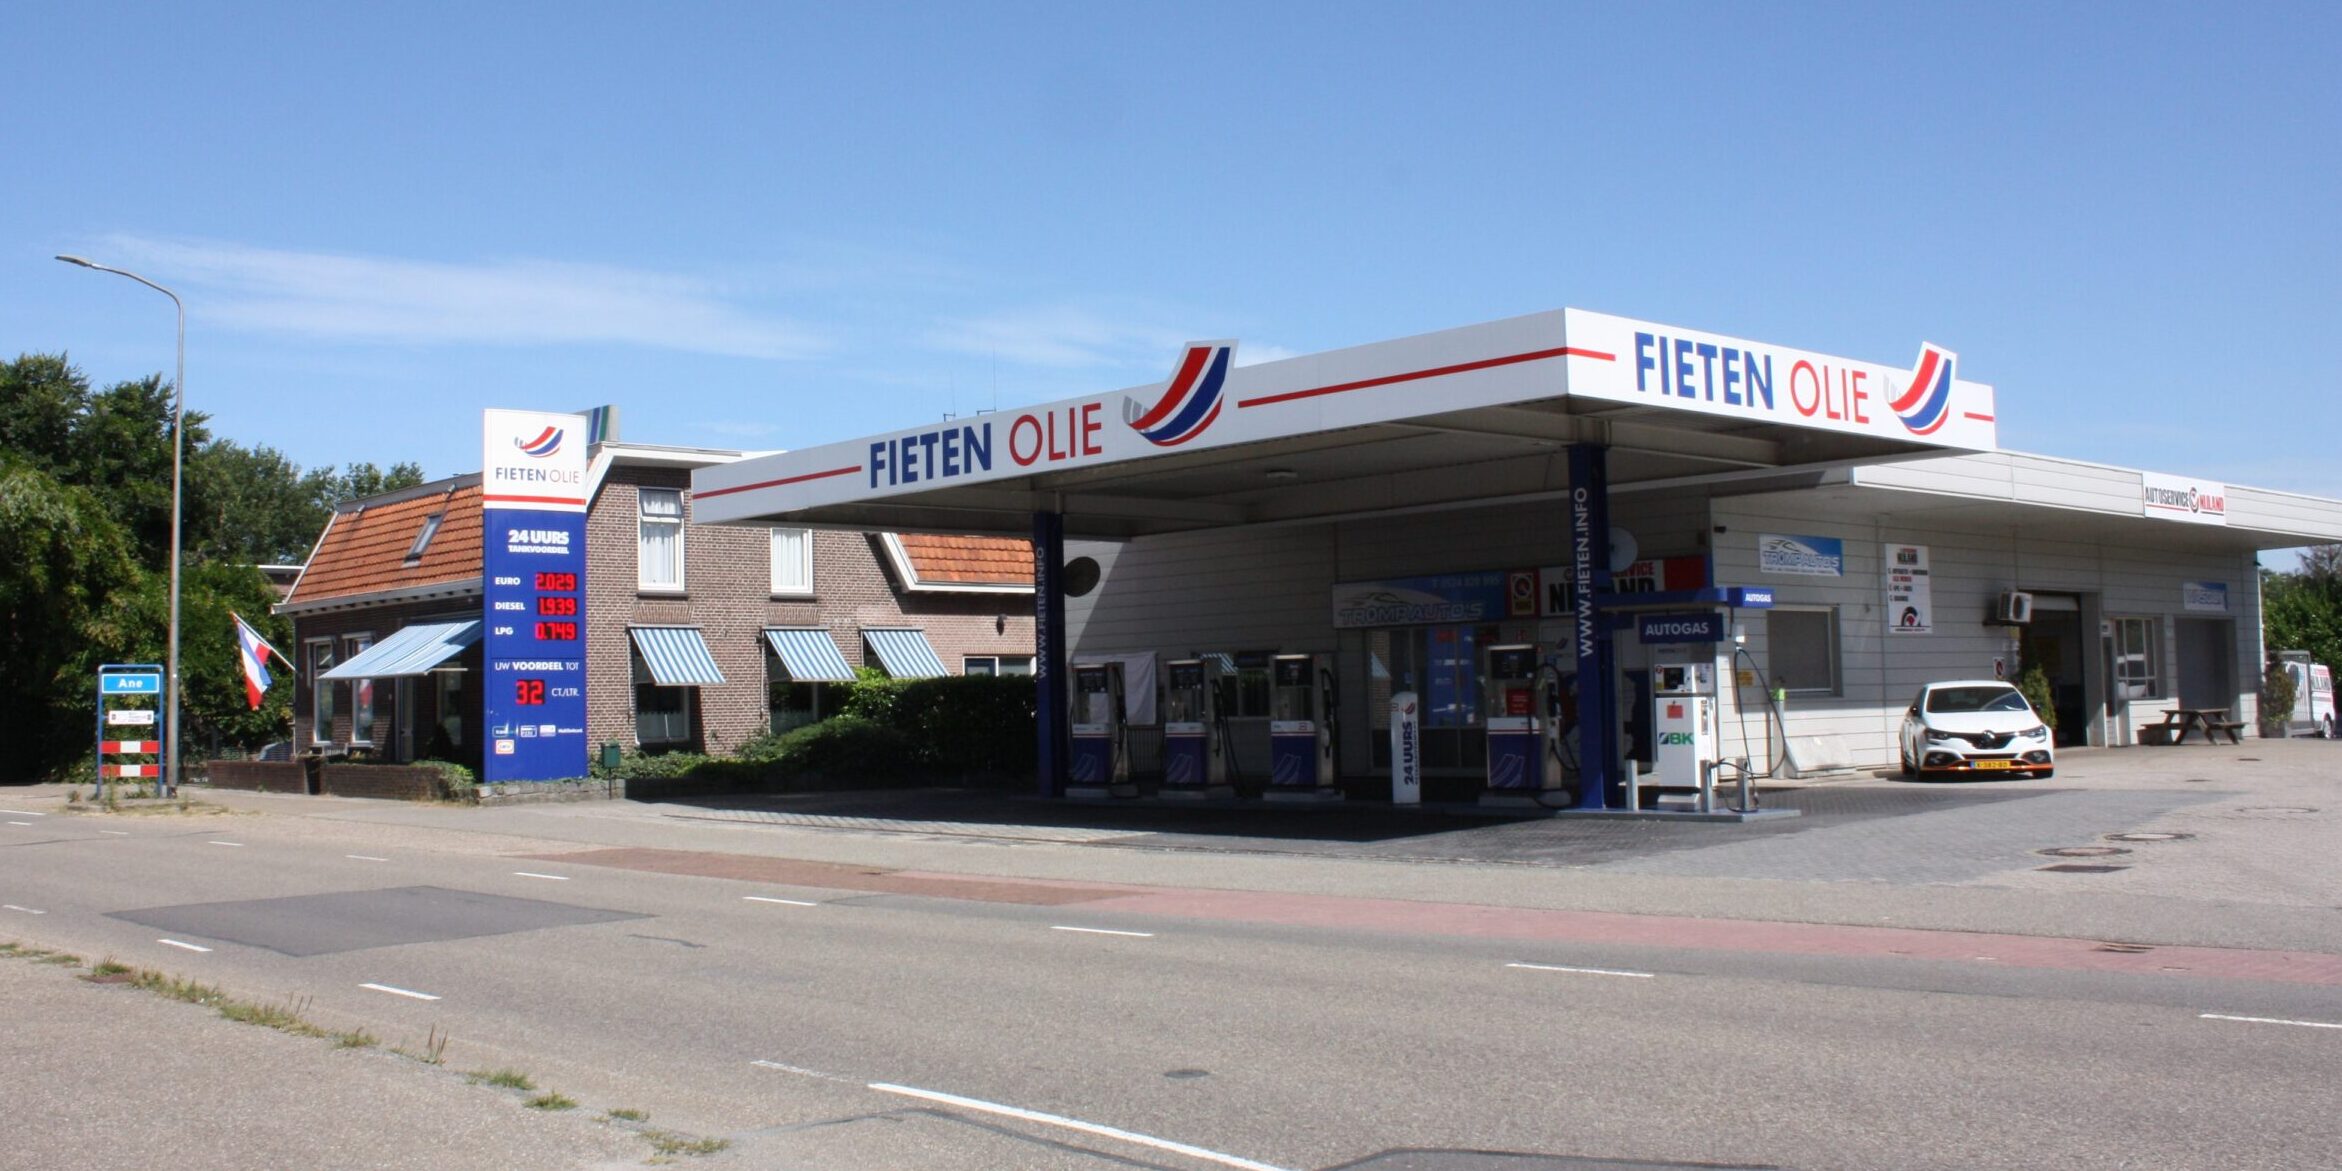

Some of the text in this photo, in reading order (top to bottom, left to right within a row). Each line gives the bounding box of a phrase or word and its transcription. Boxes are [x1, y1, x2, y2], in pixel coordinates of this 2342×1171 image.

[1635, 332, 1869, 424] FIETEN OLIE
[869, 402, 1101, 488] FIETEN OLIE
[495, 467, 579, 484] FIETEN OLIE
[2145, 486, 2189, 507] AUTOSERVICE
[508, 529, 569, 544] 24 UURS
[1574, 488, 1593, 657] WWW.FIETEN.INFO
[495, 573, 575, 591] EURO 2.029
[495, 598, 575, 616] DIESEL 1.939
[1745, 594, 1772, 602] AUTOGAS
[495, 622, 575, 640] LPG 0.749
[1645, 622, 1709, 636] AUTOGAS
[495, 662, 579, 670] UW VOORDEEL TOT
[119, 678, 143, 688] Ane
[515, 680, 544, 705] 32
[1402, 722, 1414, 786] 24 UURS
